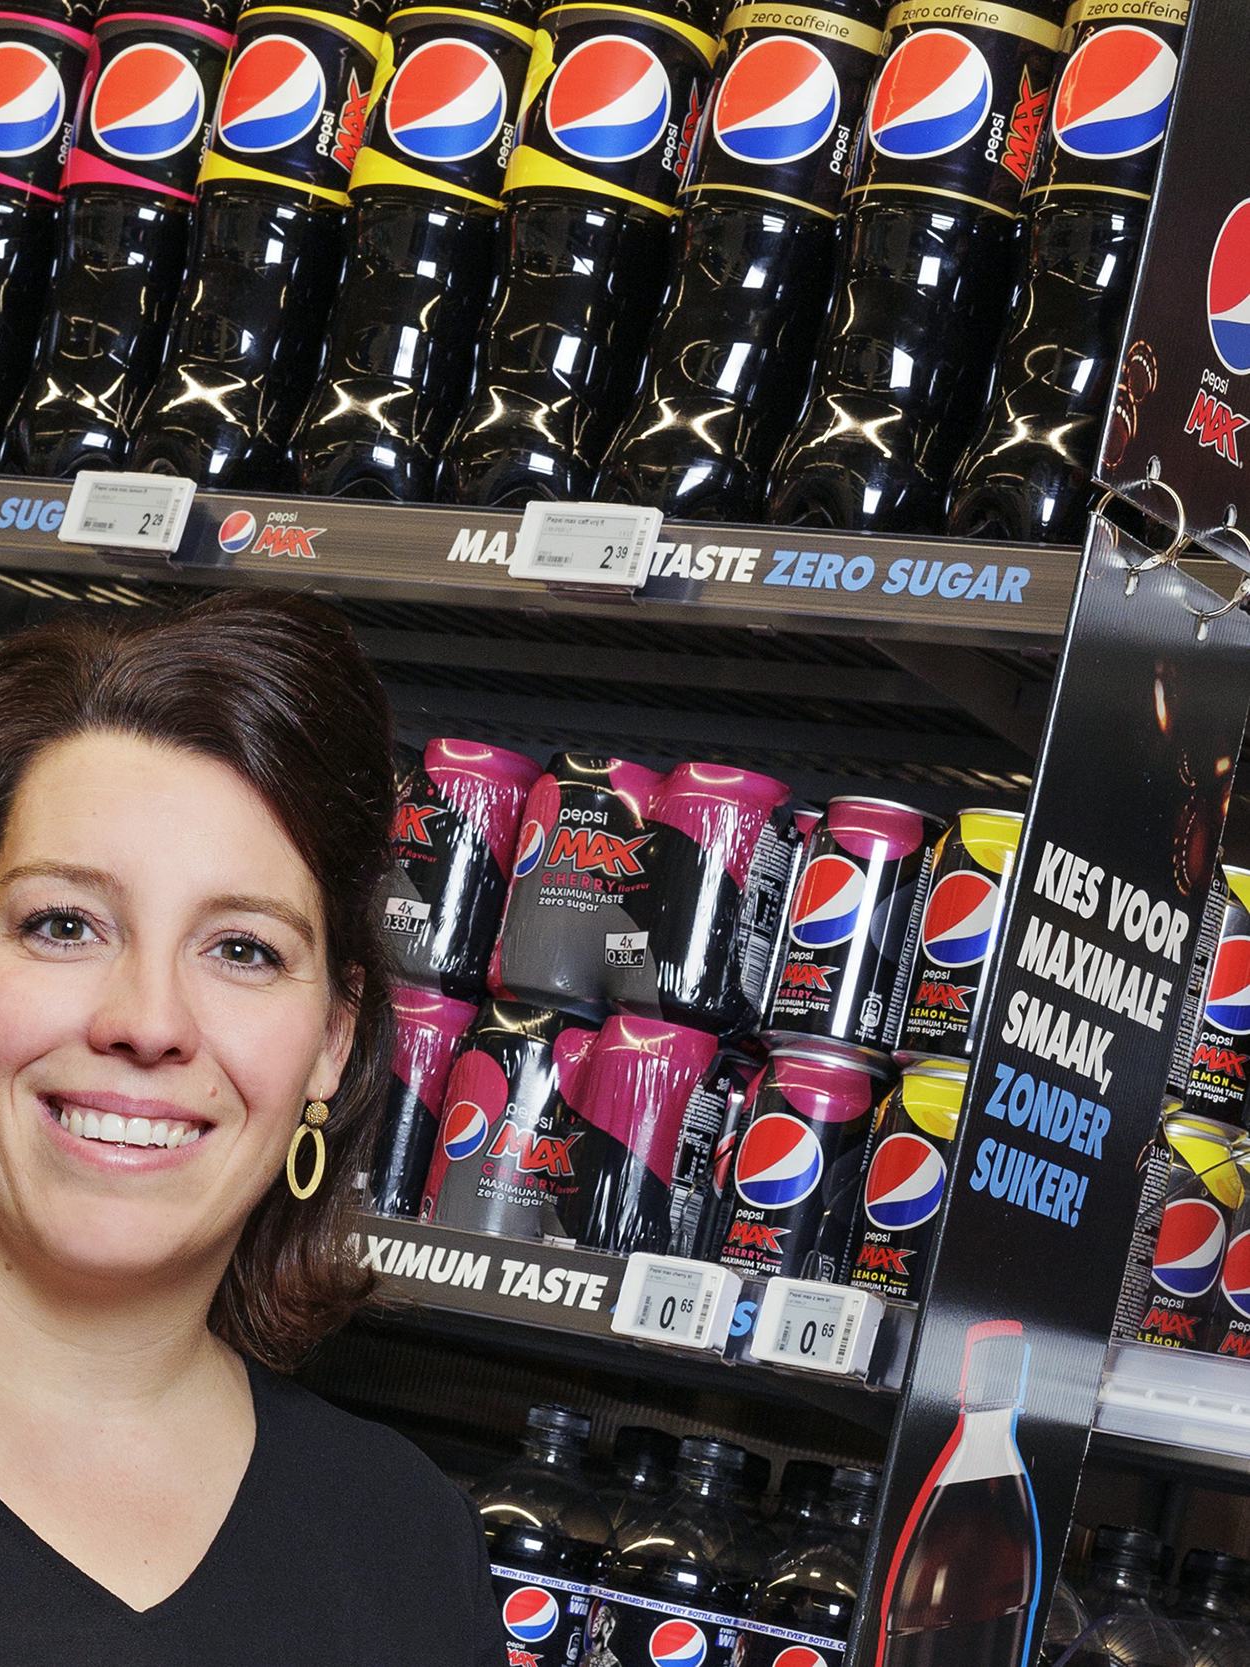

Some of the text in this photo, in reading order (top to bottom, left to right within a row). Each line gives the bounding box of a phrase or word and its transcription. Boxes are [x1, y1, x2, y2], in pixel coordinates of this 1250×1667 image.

[902, 4, 999, 25] zero caffeine
[1087, 2, 1121, 16] zero
[751, 12, 850, 39] zero caffeine
[316, 110, 335, 157] pepsi
[1000, 63, 1050, 185] MAX
[497, 122, 515, 169] pepsi
[661, 122, 679, 171] pepsi
[984, 112, 1005, 163] pepsi
[829, 124, 851, 175] pepsi
[1200, 368, 1229, 395] pepsi
[1184, 387, 1250, 467] MAX
[267, 511, 298, 524] pepsi
[251, 524, 327, 558] MAX
[649, 541, 761, 585] TASTE
[763, 550, 871, 591] ZERO
[881, 558, 1031, 604] SUGAR
[559, 807, 608, 826] pepsi
[545, 826, 658, 877] MAX
[542, 872, 616, 893] CHERRY
[538, 896, 599, 912] zero sugar
[540, 887, 624, 904] MAXIMUM TASTE
[1034, 841, 1104, 919] KIES
[1107, 876, 1190, 964] VOOR
[620, 935, 633, 949] 4x
[788, 950, 814, 962] pepsi
[781, 962, 840, 993] MAX
[922, 969, 950, 981] pepsi
[1016, 916, 1172, 1032] MAXIMALE
[806, 1001, 830, 1012] TASTE
[913, 980, 978, 1013] MAX
[786, 1007, 808, 1016] sugar
[910, 1008, 947, 1020] LEMON
[907, 1025, 946, 1037] zero sugar
[908, 1018, 968, 1033] MAXIMUM TASTE
[1001, 990, 1114, 1095] SMAAK,
[1201, 1032, 1234, 1047] pepsi
[1193, 1042, 1250, 1080] MAX
[1192, 1069, 1230, 1087] EMON
[1188, 1080, 1244, 1101] AXIMUM TASTE
[1203, 1092, 1228, 1103] sugar
[506, 1103, 554, 1131] pepsi
[984, 1063, 1112, 1160] ZONDER
[486, 1119, 586, 1176] MAX
[479, 1177, 537, 1198] MAXIMUM
[969, 1137, 1089, 1228] SUIKER!
[477, 1188, 544, 1207] zero sugar
[736, 1208, 765, 1221] pepsi
[727, 1220, 792, 1254] MAX
[864, 1231, 891, 1243] pepsi
[722, 1246, 763, 1260] CHERRY
[855, 1243, 917, 1276] MAX
[719, 1255, 781, 1274] MAXIMUM TASTE
[498, 1258, 608, 1311] TASTE
[852, 1269, 887, 1283] LEMON
[883, 1284, 908, 1296] TASTE
[1153, 1295, 1185, 1309] pepsi
[1140, 1306, 1200, 1340] MAX
[1137, 1332, 1180, 1348] LEMON
[664, 1603, 686, 1615] EVERY
[786, 1630, 808, 1642] EVERY
